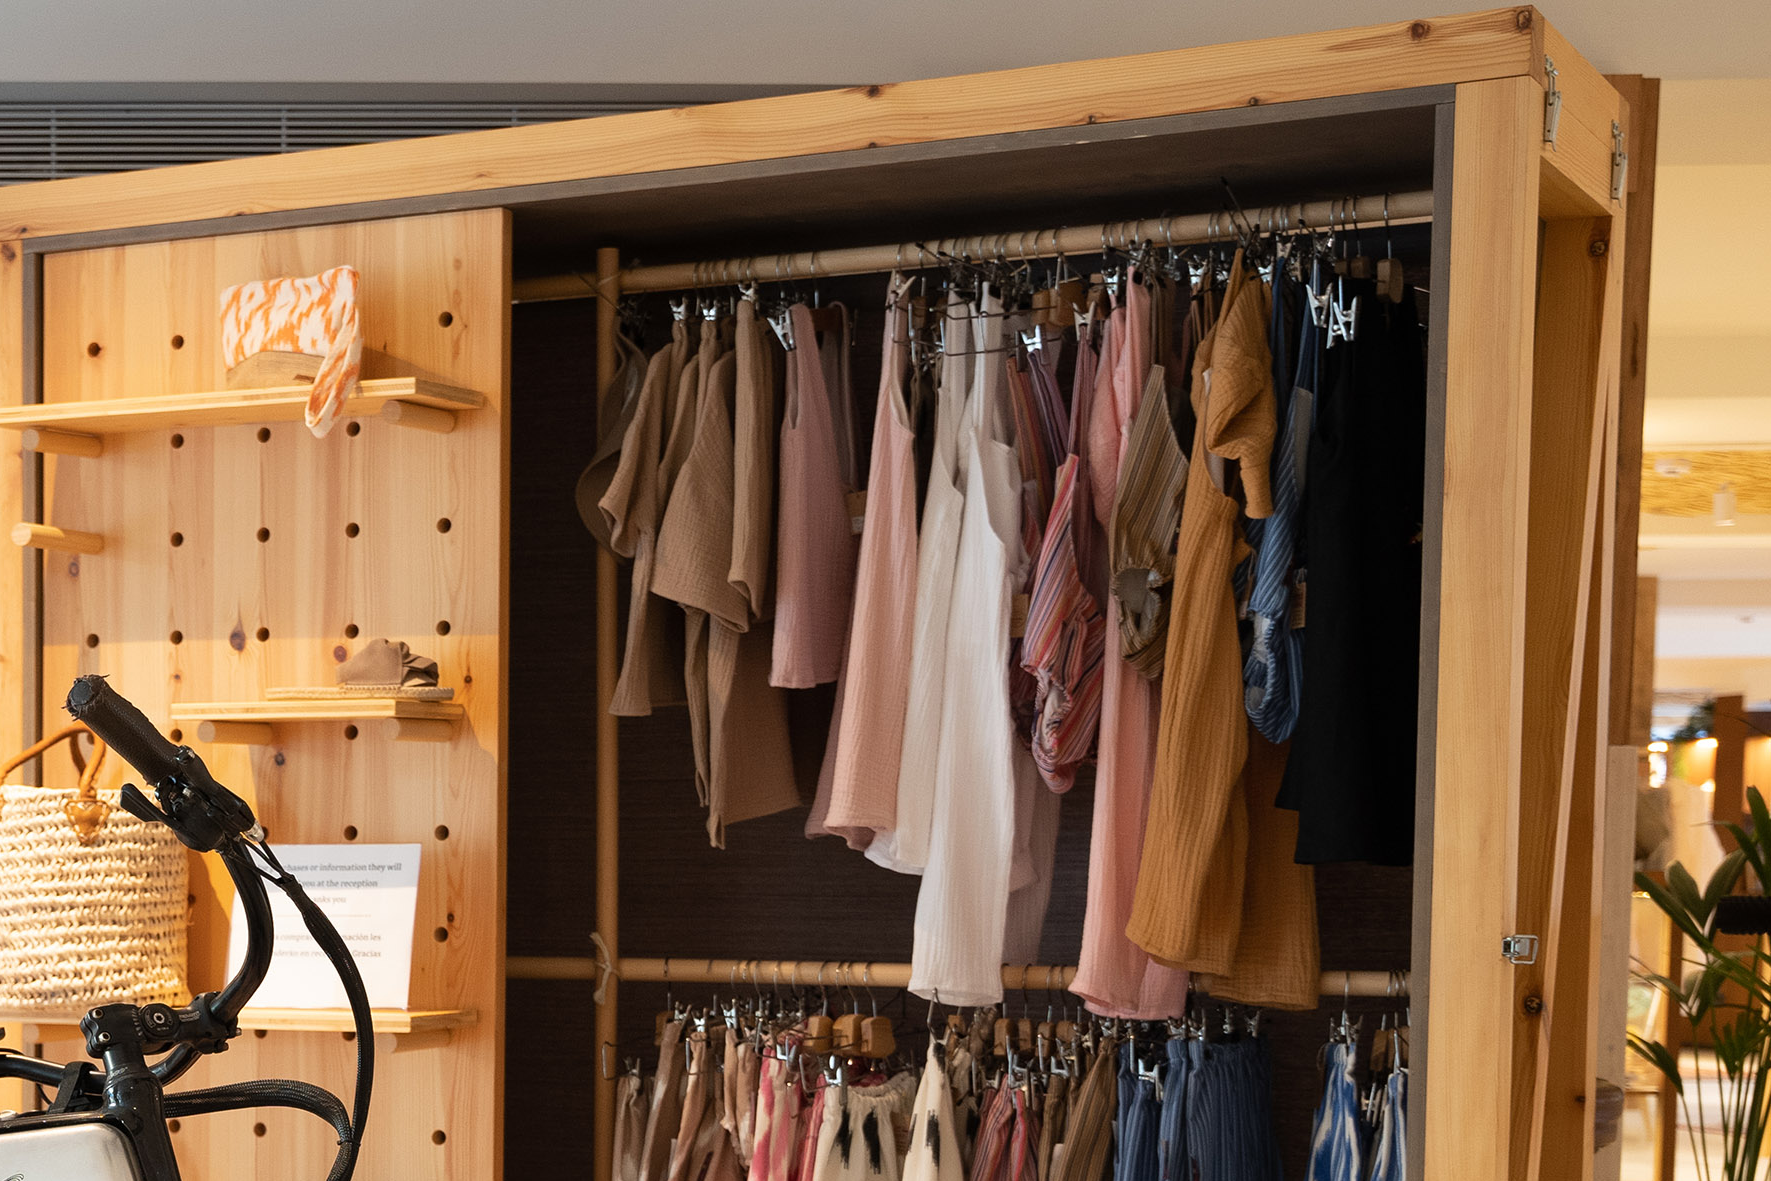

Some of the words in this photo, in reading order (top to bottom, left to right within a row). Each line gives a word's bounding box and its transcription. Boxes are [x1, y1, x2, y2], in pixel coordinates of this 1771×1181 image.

[319, 862, 367, 871] information
[368, 862, 386, 873] they
[387, 862, 402, 871] will
[326, 880, 339, 888] the
[340, 879, 378, 889] reception
